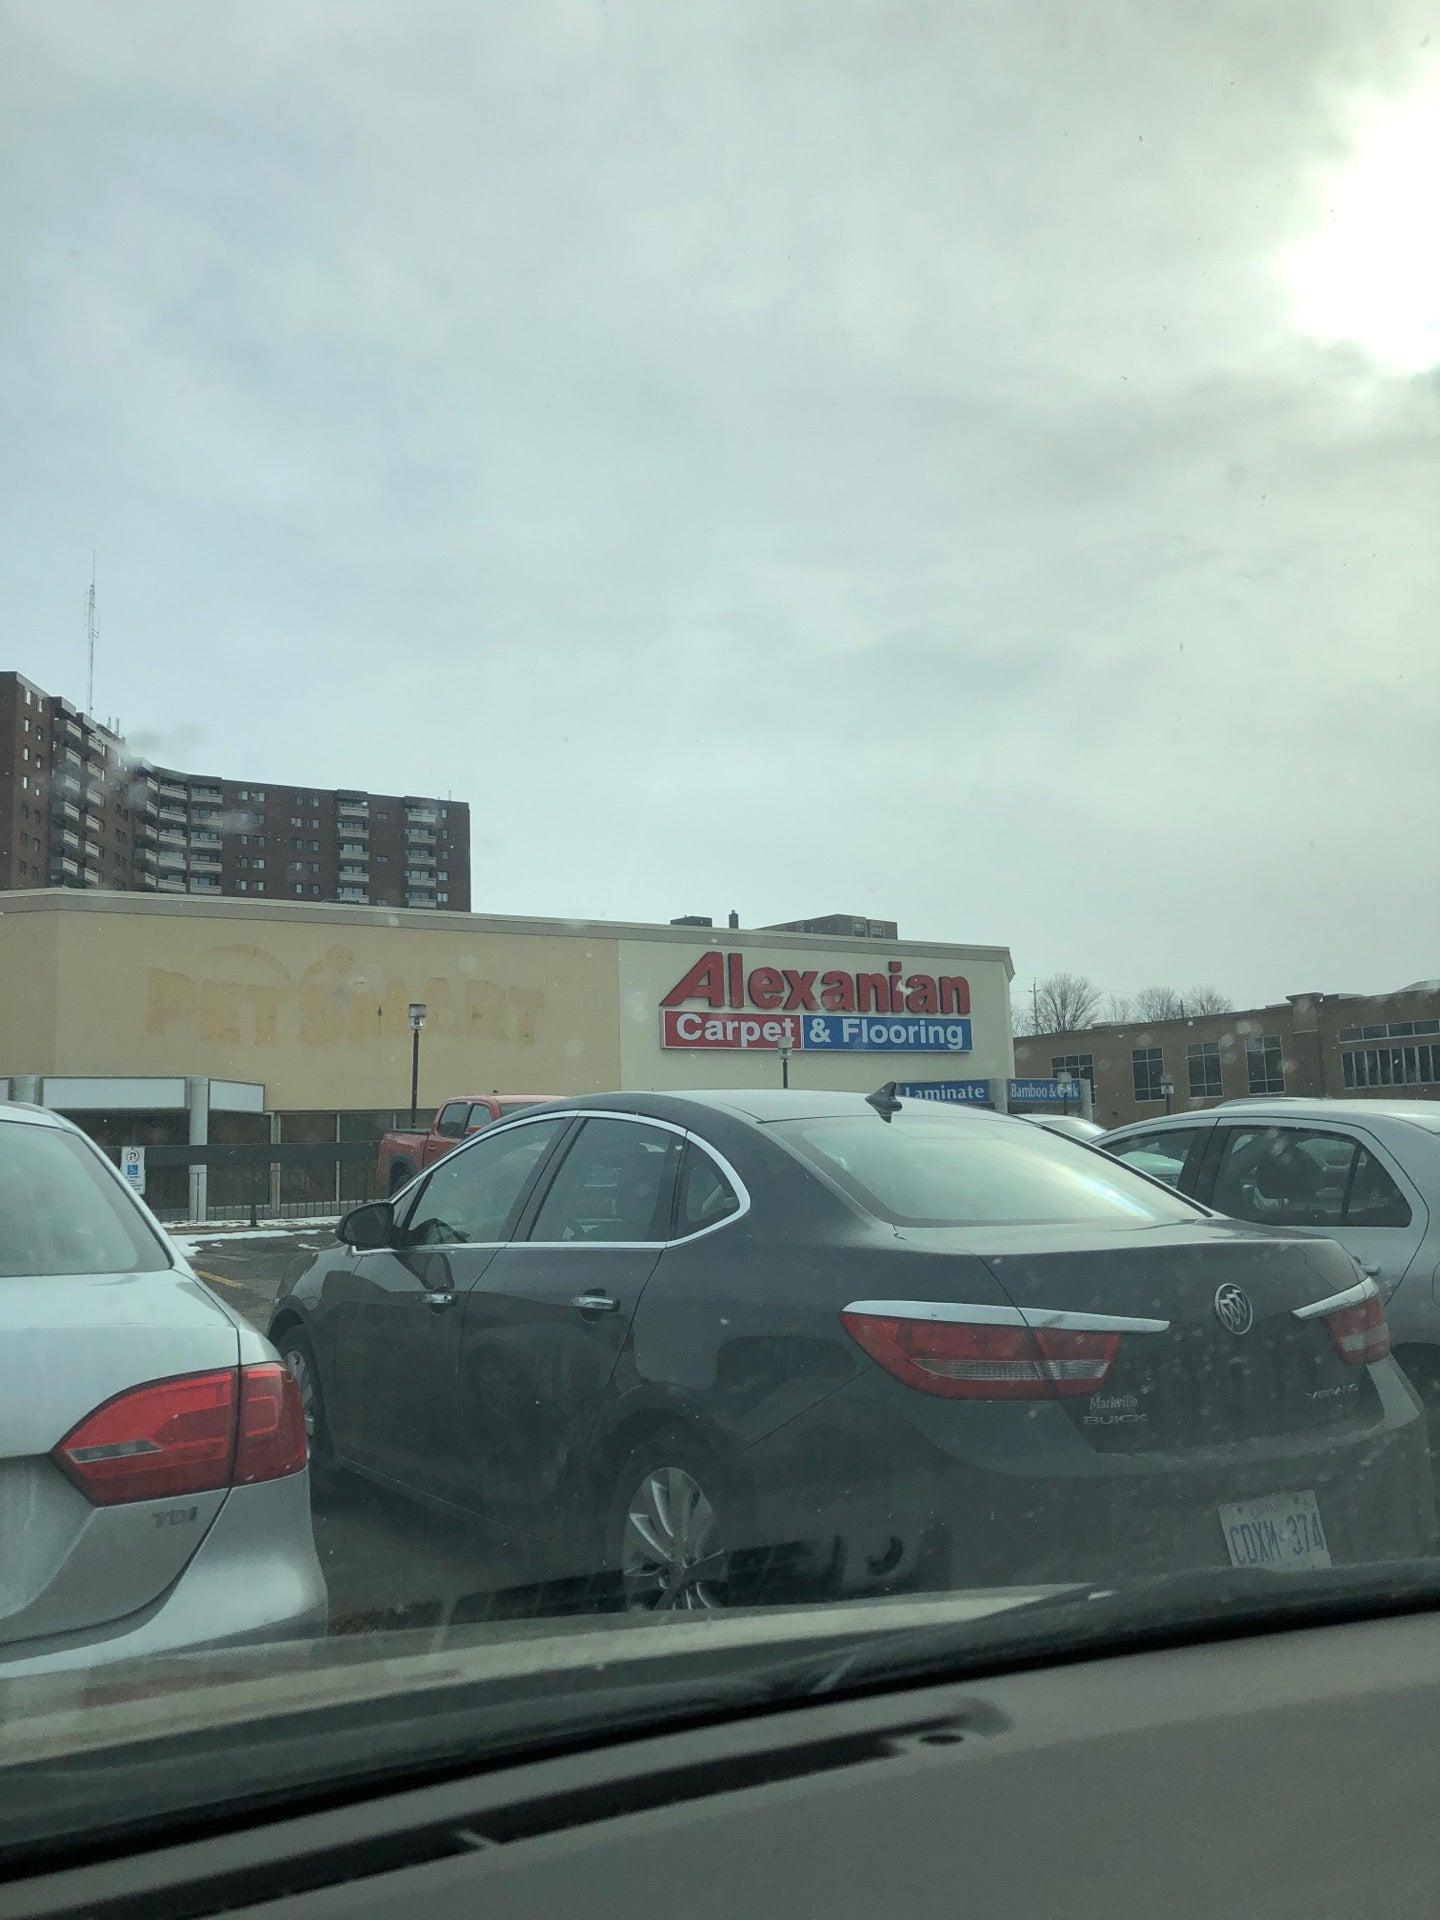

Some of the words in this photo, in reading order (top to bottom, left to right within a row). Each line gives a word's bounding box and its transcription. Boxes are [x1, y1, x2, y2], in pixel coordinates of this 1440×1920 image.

[659, 951, 971, 1014] Alexanian
[676, 1013, 795, 1047] Carpet
[809, 1020, 832, 1043] &
[842, 1018, 963, 1048] Flooring
[905, 1084, 985, 1100] Laminate
[1011, 1083, 1048, 1098] Bamboo
[1049, 1083, 1057, 1098] &
[1057, 1083, 1079, 1098] Crk
[1083, 1413, 1149, 1425] BUICK
